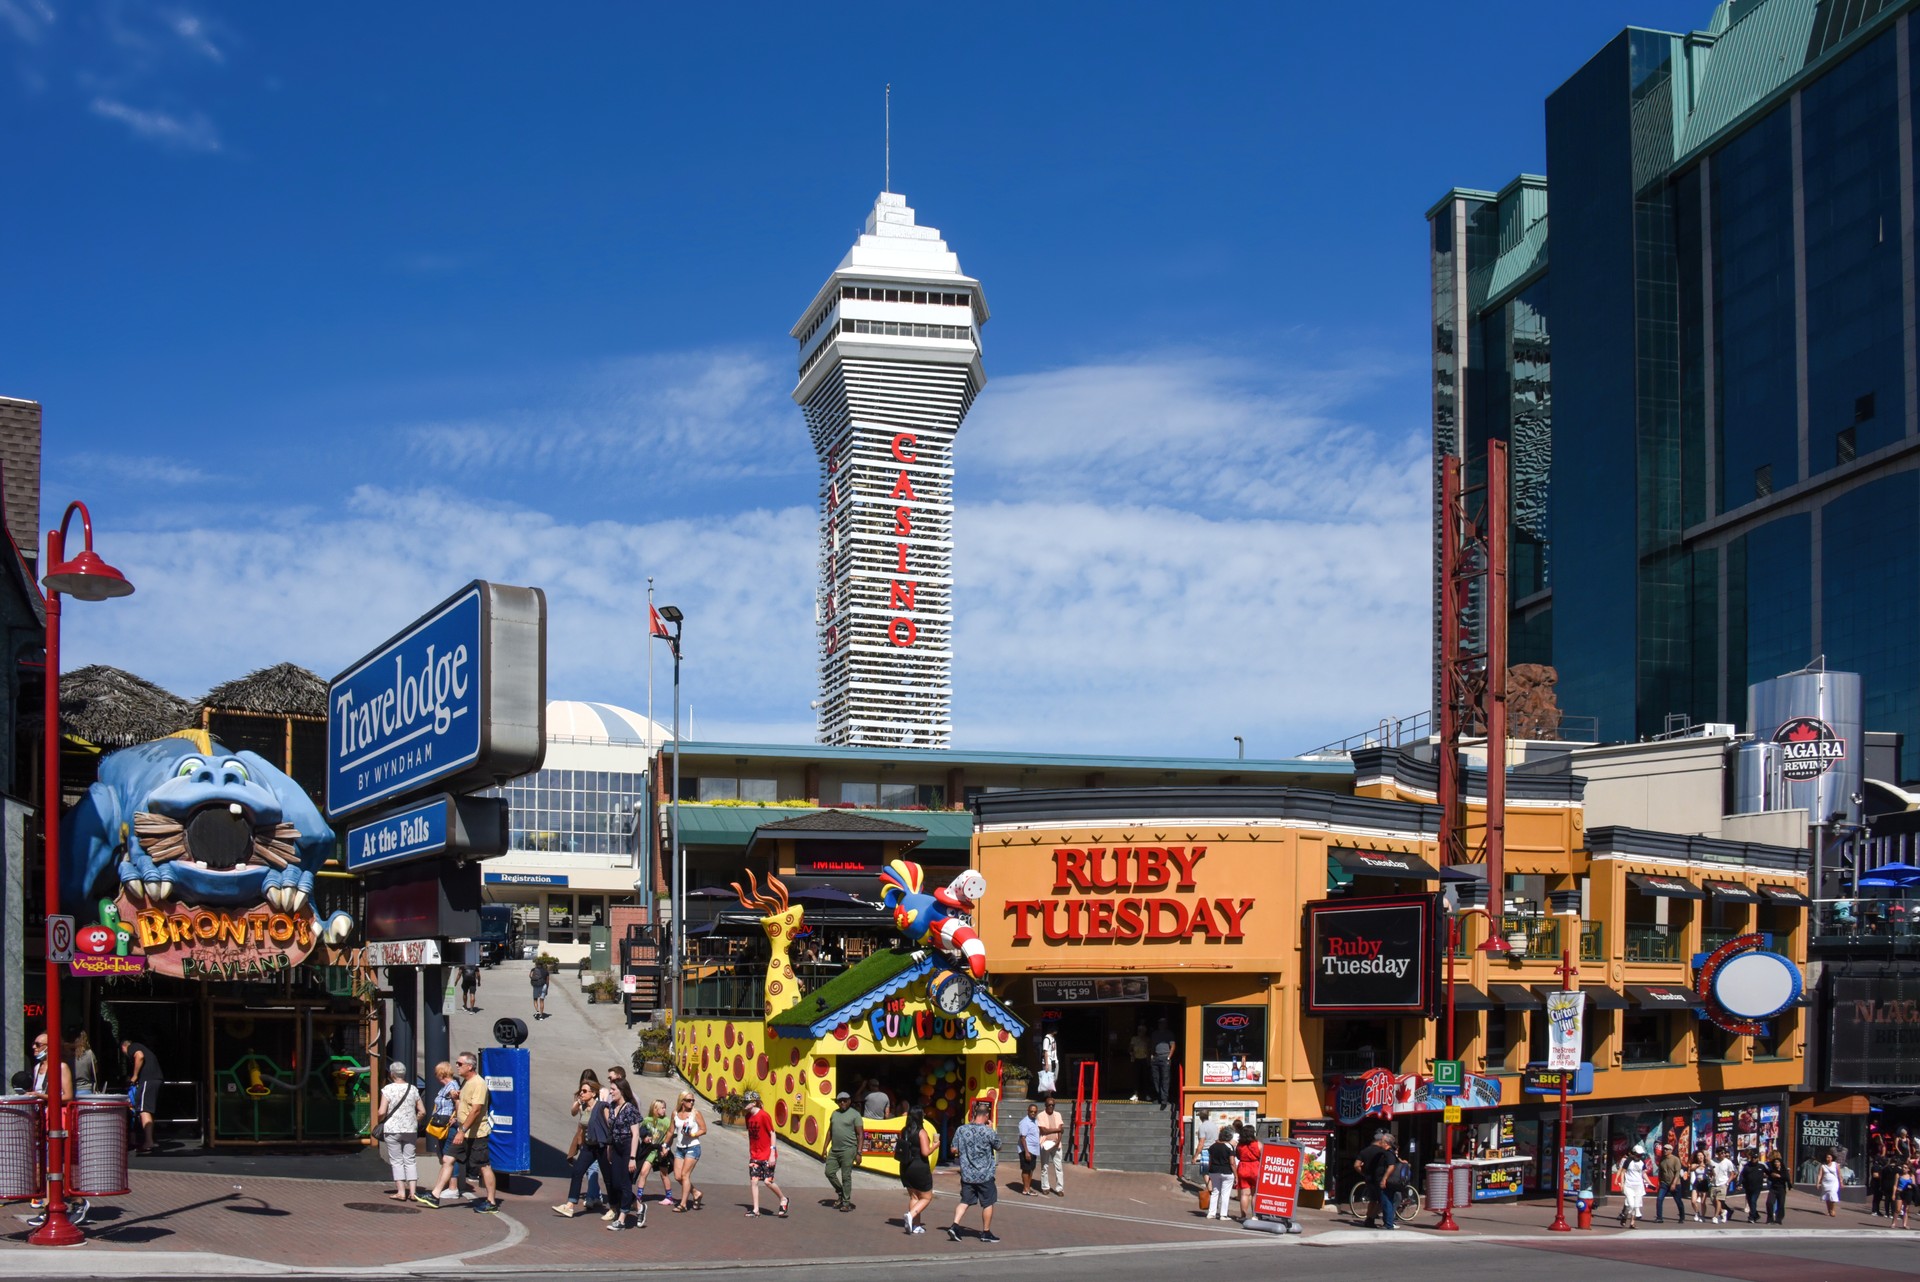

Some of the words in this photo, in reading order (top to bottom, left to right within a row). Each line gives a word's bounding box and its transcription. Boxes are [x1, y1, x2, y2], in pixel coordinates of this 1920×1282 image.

[888, 433, 917, 647] CASINO
[337, 644, 468, 757] Travelodge
[1784, 742, 1843, 759] AGARA
[359, 774, 369, 790] BY
[374, 742, 432, 783] WYNDHAM
[1784, 760, 1828, 771] REWING
[362, 832, 376, 858] At
[379, 826, 397, 852] the
[401, 815, 429, 848] Falls
[1052, 847, 1207, 888] RUBY
[501, 874, 551, 883] Registration
[1005, 898, 1255, 939] TUESDAY
[1328, 936, 1382, 959] Ruby
[72, 957, 141, 973] VeggieTales
[182, 954, 290, 978] PLAYLAND
[1322, 955, 1410, 978] Tuesday
[24, 1004, 44, 1017] PEN
[887, 998, 905, 1012] THE
[1219, 1016, 1249, 1026] OPEN
[1550, 1006, 1578, 1022] Clifton
[870, 1008, 913, 1041] FUN
[916, 1010, 978, 1040] HOUSE
[1559, 1018, 1575, 1032] Hill
[1442, 1066, 1453, 1080] P
[1539, 1074, 1560, 1084] BIG
[1361, 1072, 1394, 1111] Gifts
[1803, 1120, 1840, 1128] CRAFT
[1802, 1127, 1839, 1137] BEER
[1802, 1136, 1808, 1145] IS
[1809, 1136, 1839, 1147] BREWING
[1265, 1156, 1295, 1167] PUBLIC
[1264, 1164, 1294, 1175] PARKING
[1491, 1170, 1506, 1183] BIG
[1262, 1172, 1292, 1188] FULL
[1260, 1204, 1276, 1212] PARKING
